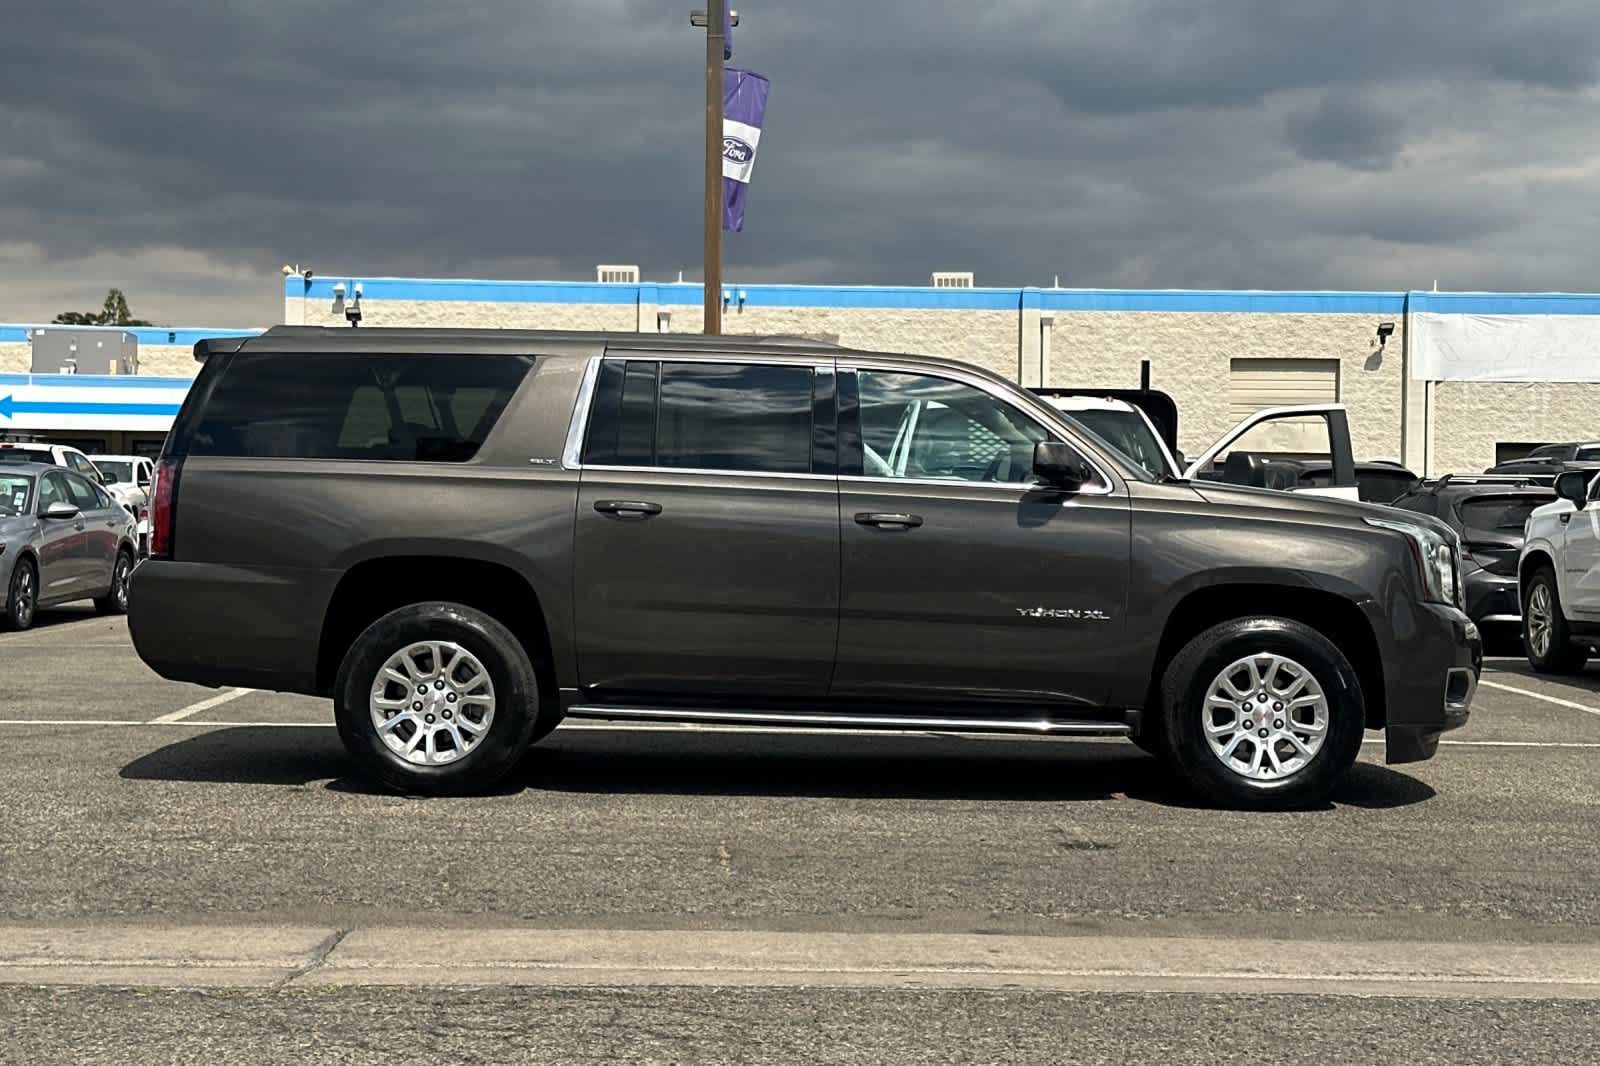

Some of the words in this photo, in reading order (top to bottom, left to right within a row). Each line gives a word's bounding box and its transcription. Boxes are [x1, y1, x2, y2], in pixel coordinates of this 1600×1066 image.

[723, 140, 746, 161] Ford
[1016, 607, 1081, 618] YUKON
[1082, 610, 1111, 619] XL
